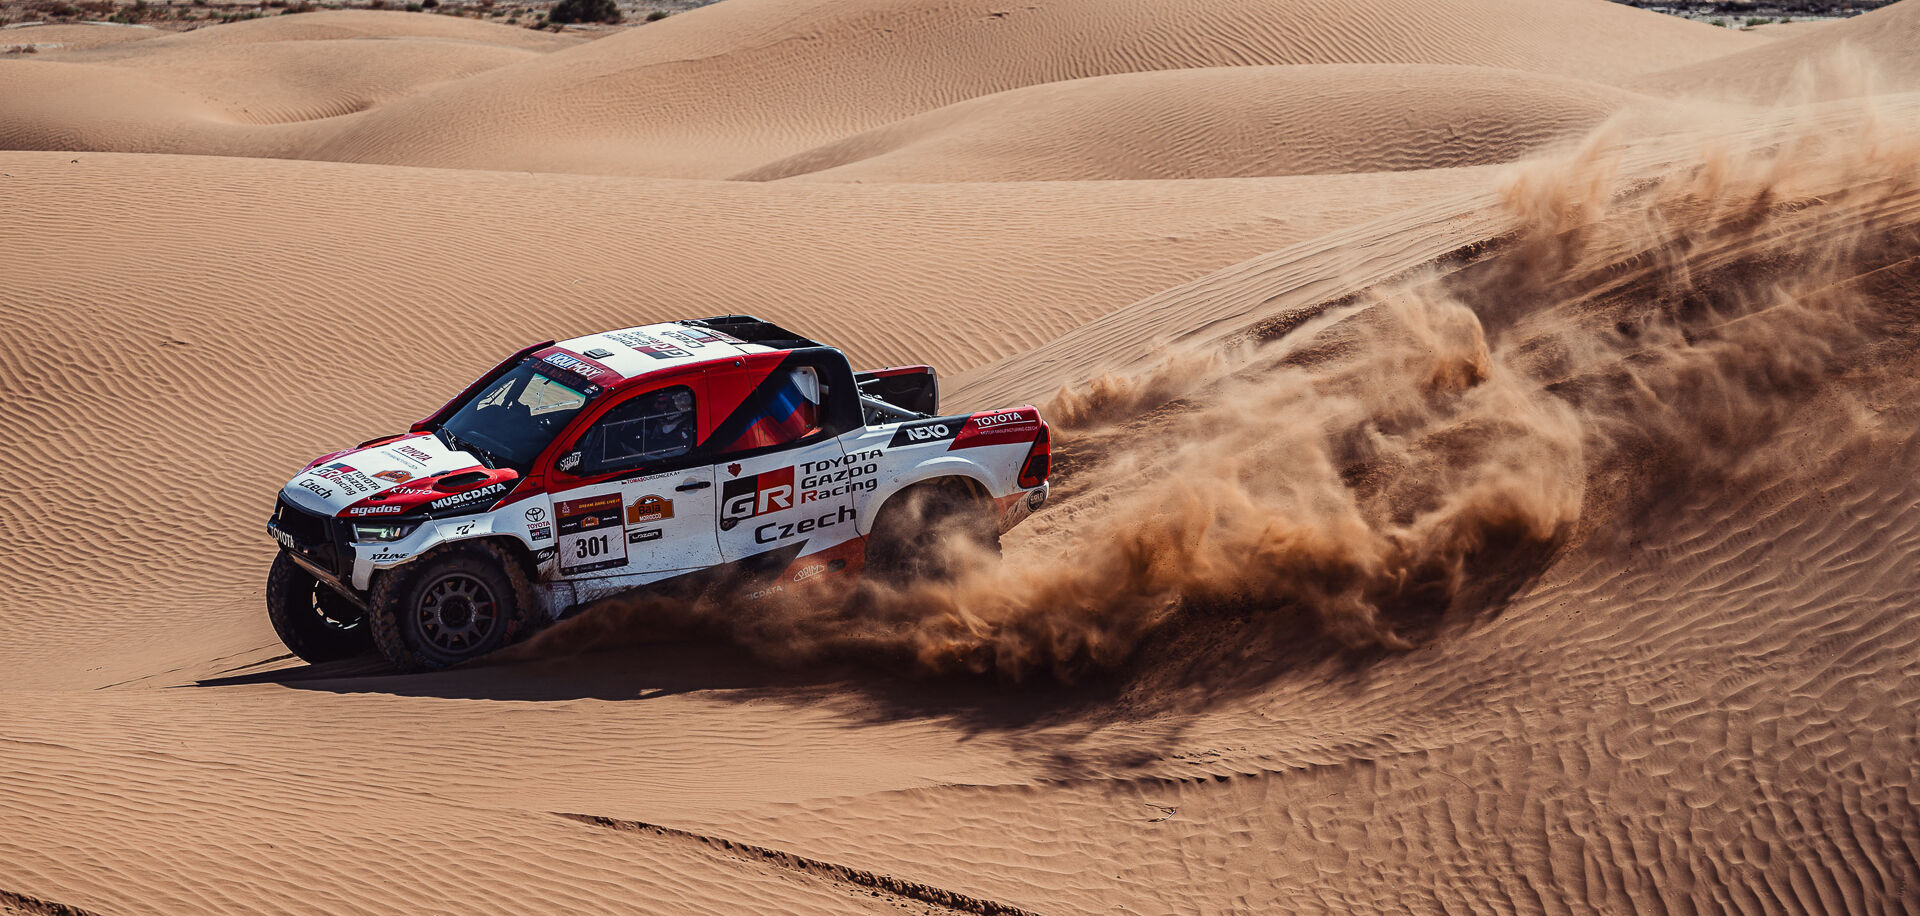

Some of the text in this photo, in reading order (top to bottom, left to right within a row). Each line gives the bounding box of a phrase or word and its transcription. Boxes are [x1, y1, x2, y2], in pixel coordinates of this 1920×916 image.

[974, 412, 1023, 427] TOYOTA
[906, 423, 949, 442] NEXO
[398, 445, 432, 461] TOYOTA
[800, 448, 884, 475] TOYOTA
[340, 474, 369, 493] GAZOO
[352, 471, 382, 491] TOYOTA
[801, 463, 878, 490] GAZOO
[299, 479, 333, 500] Czech
[431, 483, 507, 510] MUSICDATA
[801, 478, 878, 504] Racing
[350, 505, 401, 516] agados
[638, 504, 661, 515] Baja
[722, 484, 793, 521] GR
[527, 521, 550, 530] TOYOTA
[755, 505, 857, 545] Czech
[270, 525, 295, 549] TOYOTA
[576, 535, 608, 559] 301
[369, 552, 410, 561] XTLINE
